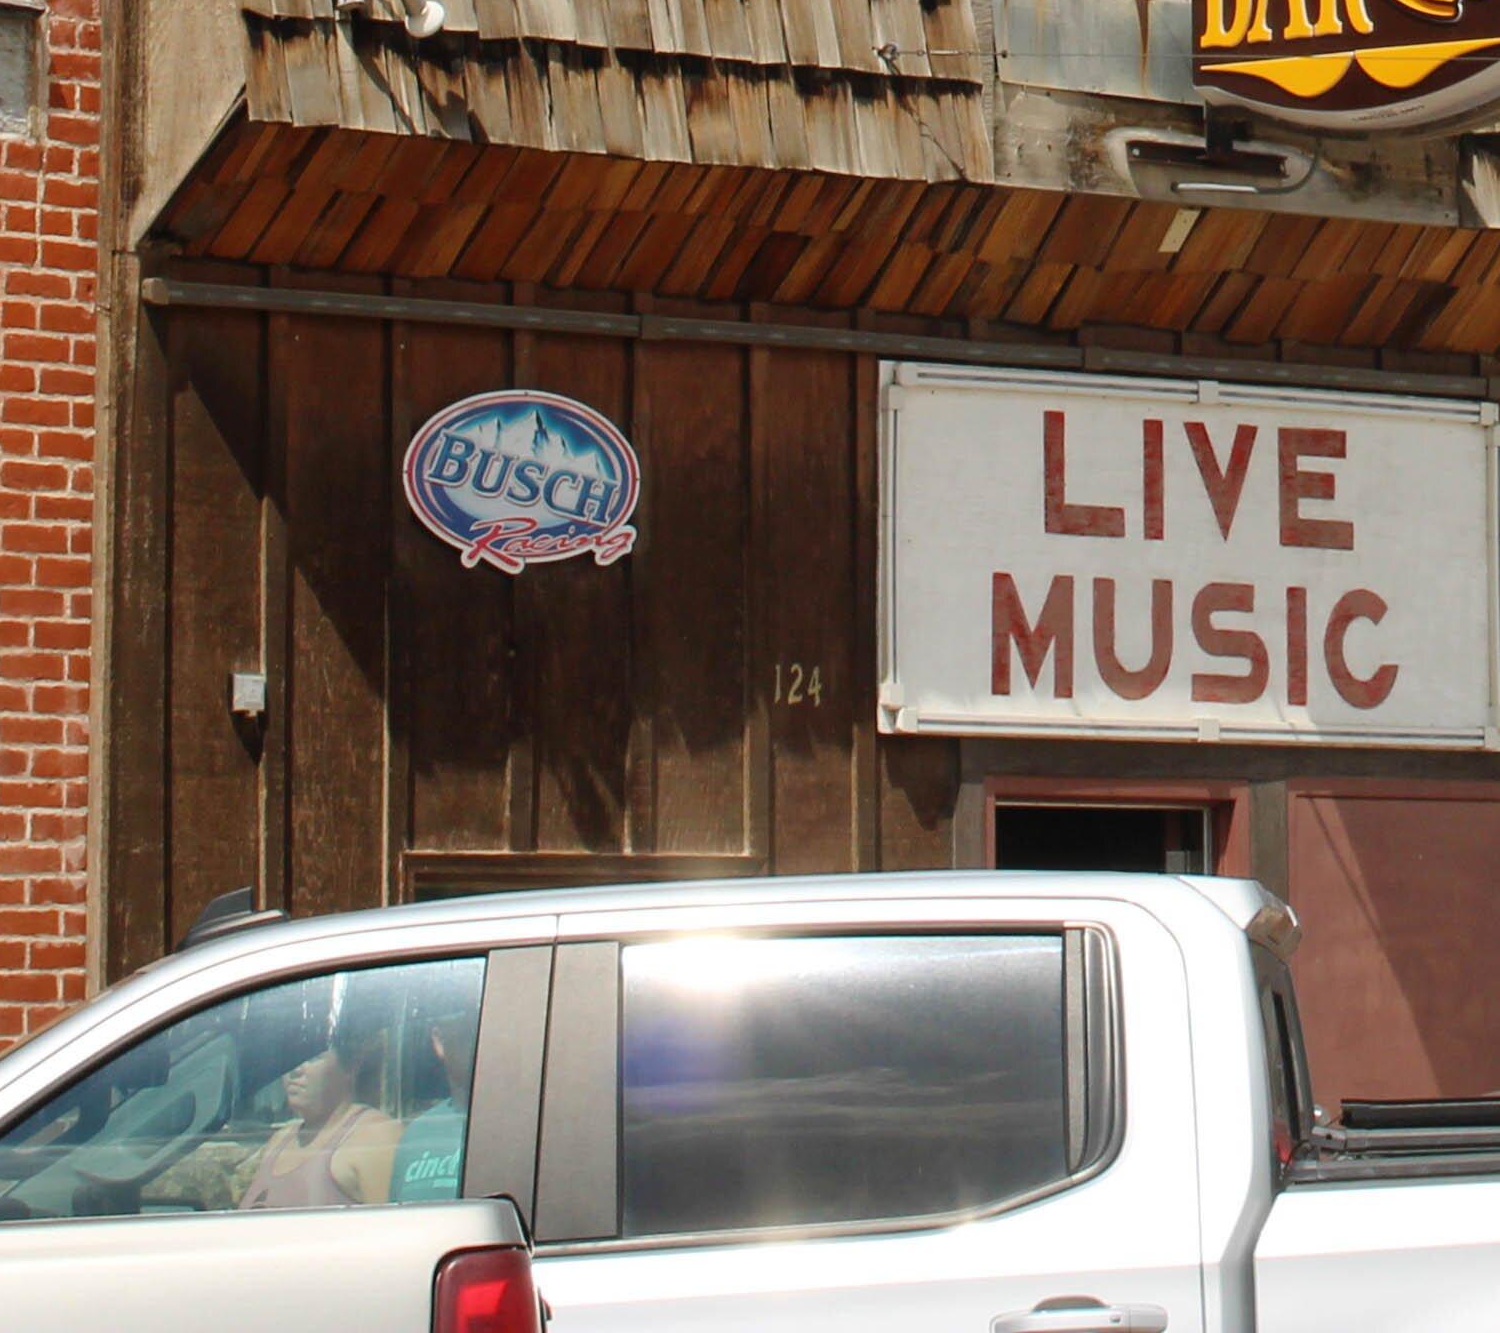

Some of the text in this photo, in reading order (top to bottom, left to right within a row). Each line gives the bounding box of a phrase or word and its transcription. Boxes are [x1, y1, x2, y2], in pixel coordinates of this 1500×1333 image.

[425, 429, 620, 525] BUSCH
[1043, 410, 1354, 550] LIVE
[470, 517, 634, 568] Racing
[774, 664, 822, 708] 124
[991, 572, 1399, 710] MUSIC
